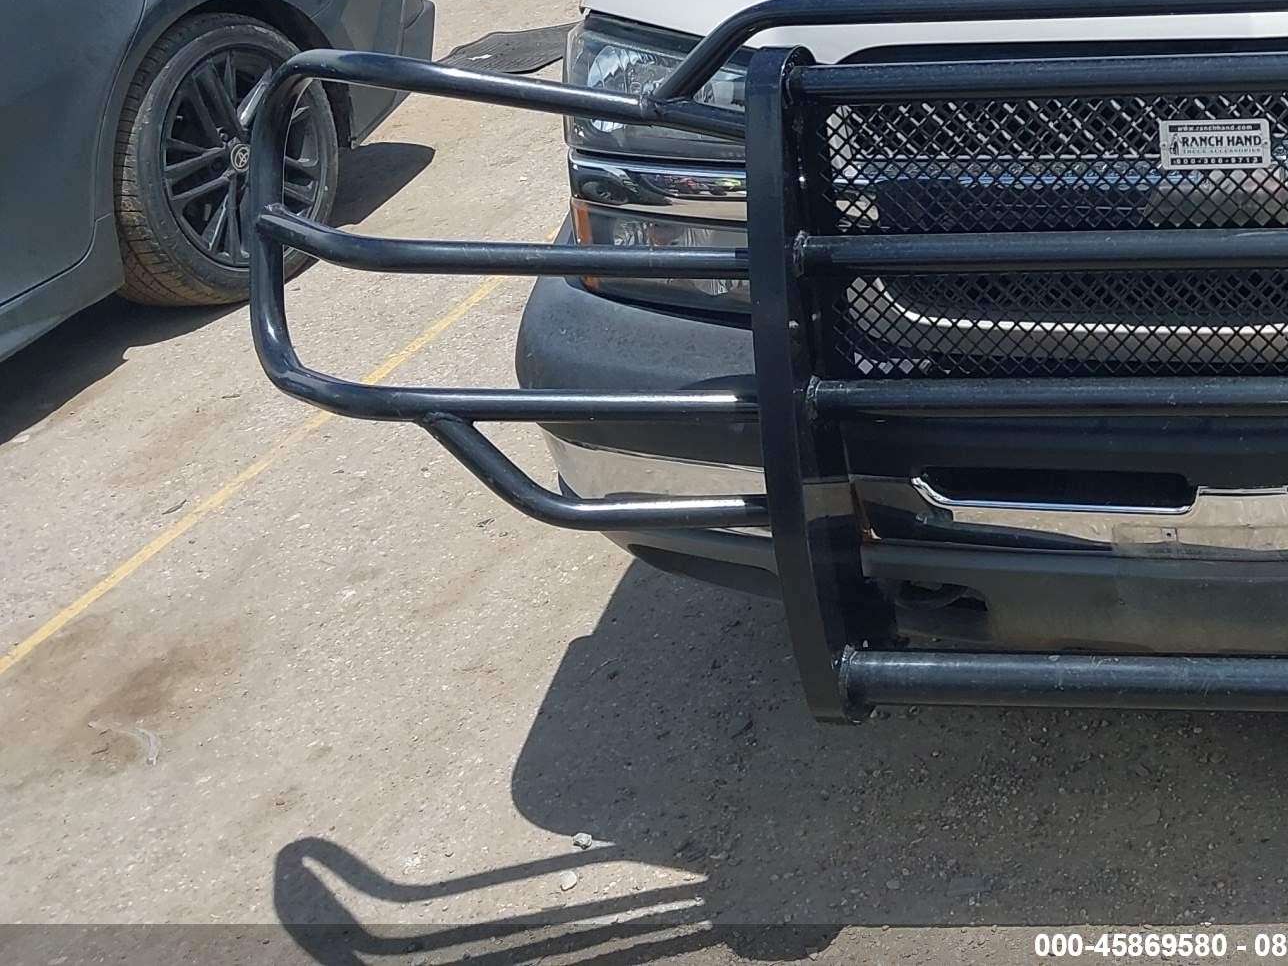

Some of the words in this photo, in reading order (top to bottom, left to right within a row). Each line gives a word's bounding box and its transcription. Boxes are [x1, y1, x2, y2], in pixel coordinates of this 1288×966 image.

[1177, 124, 1253, 132] www.ranchhand.com
[1181, 136, 1224, 147] RANCH
[1227, 135, 1262, 147] HAND
